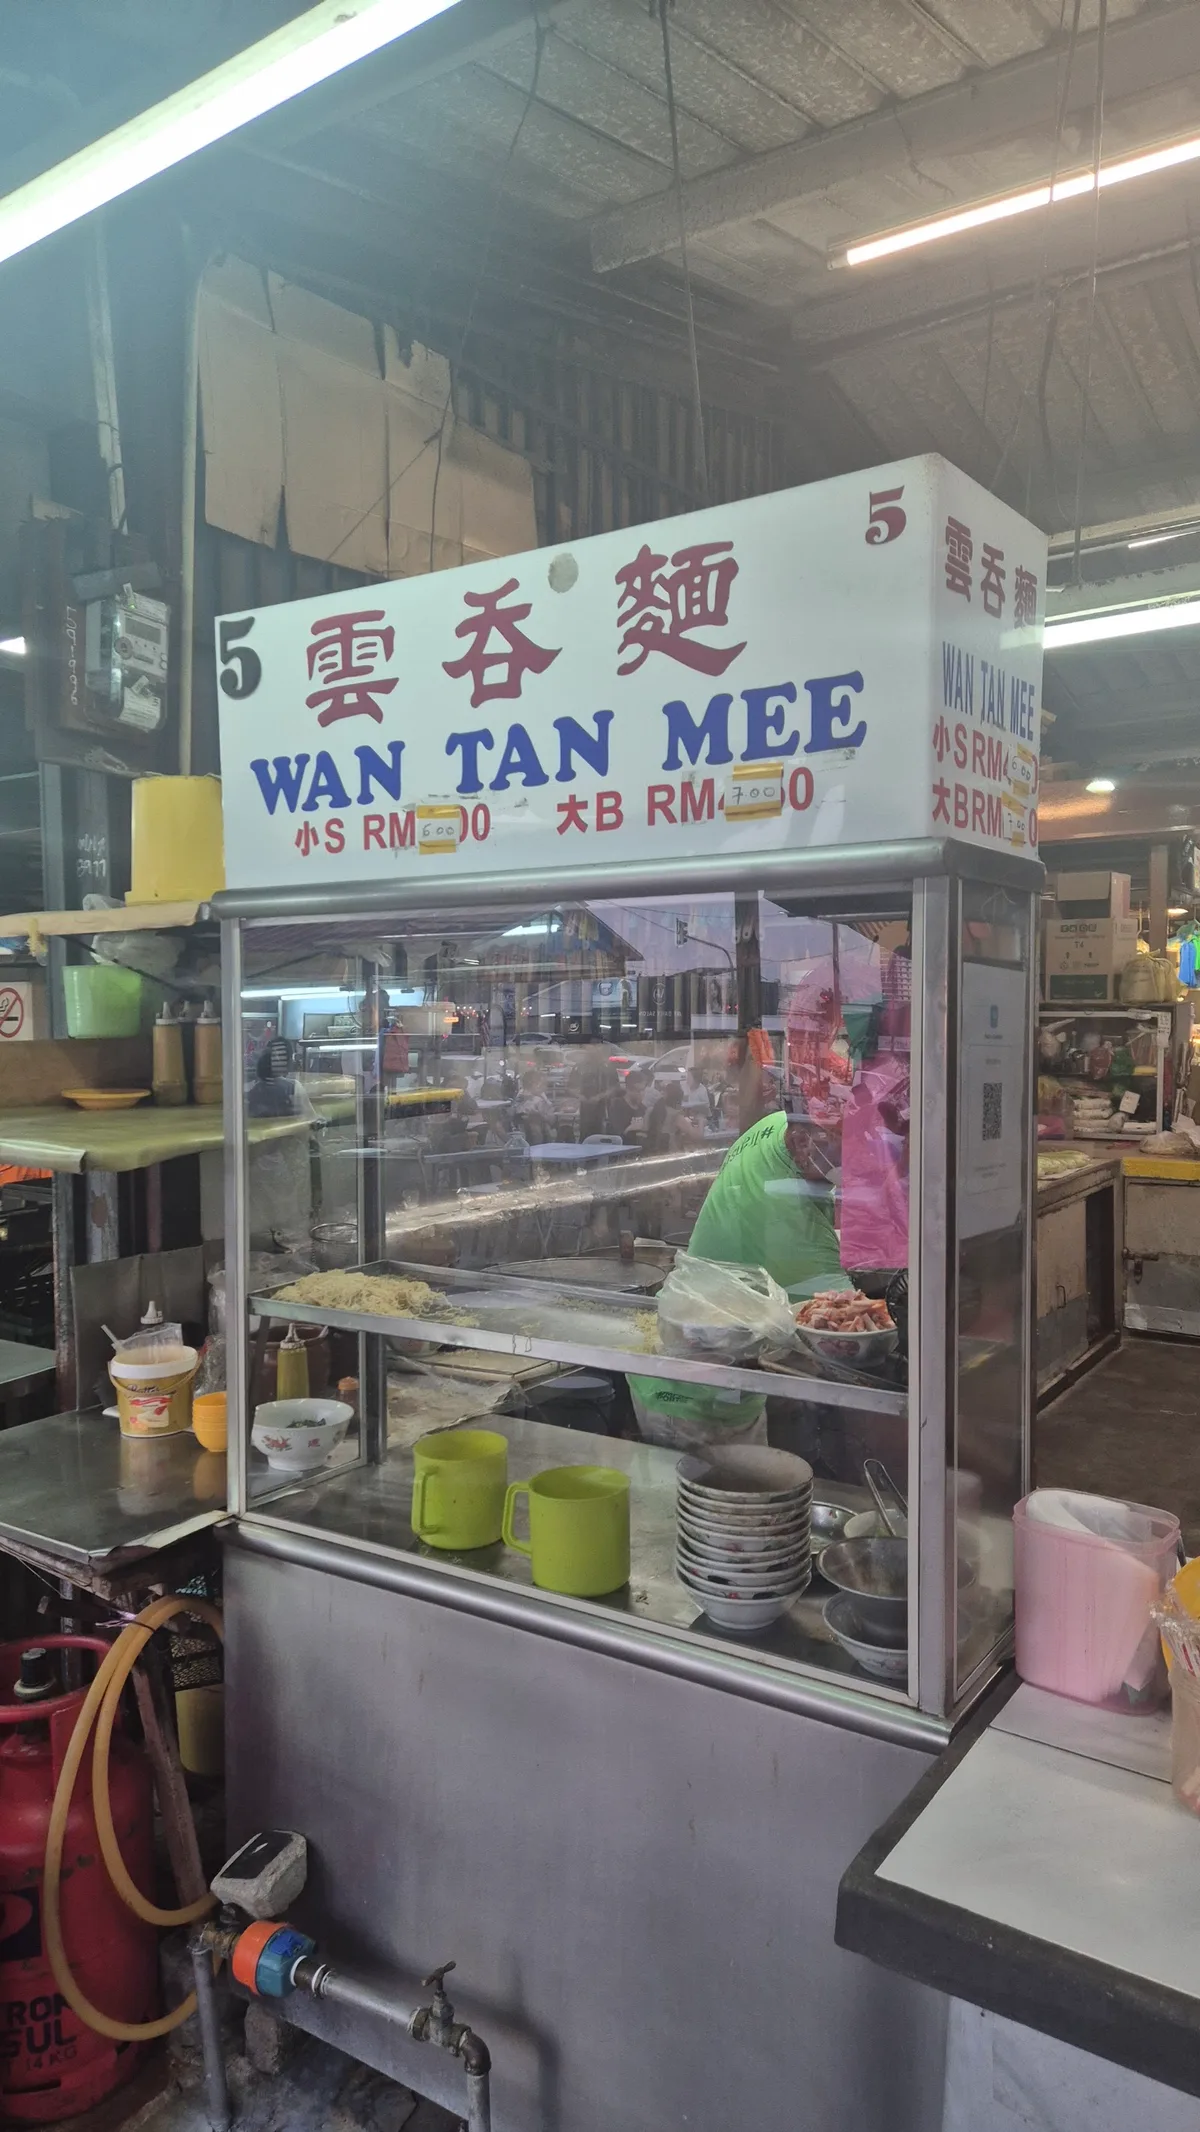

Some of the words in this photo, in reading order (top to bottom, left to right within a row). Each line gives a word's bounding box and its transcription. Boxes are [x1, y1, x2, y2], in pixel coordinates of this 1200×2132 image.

[865, 485, 907, 545] 5
[219, 616, 262, 700] 5
[943, 641, 974, 716] WAN
[1010, 676, 1035, 741] MEE
[250, 740, 405, 815] WAN
[445, 709, 614, 794] TAN
[662, 670, 868, 771] MEE
[731, 786, 776, 806] 7.00
